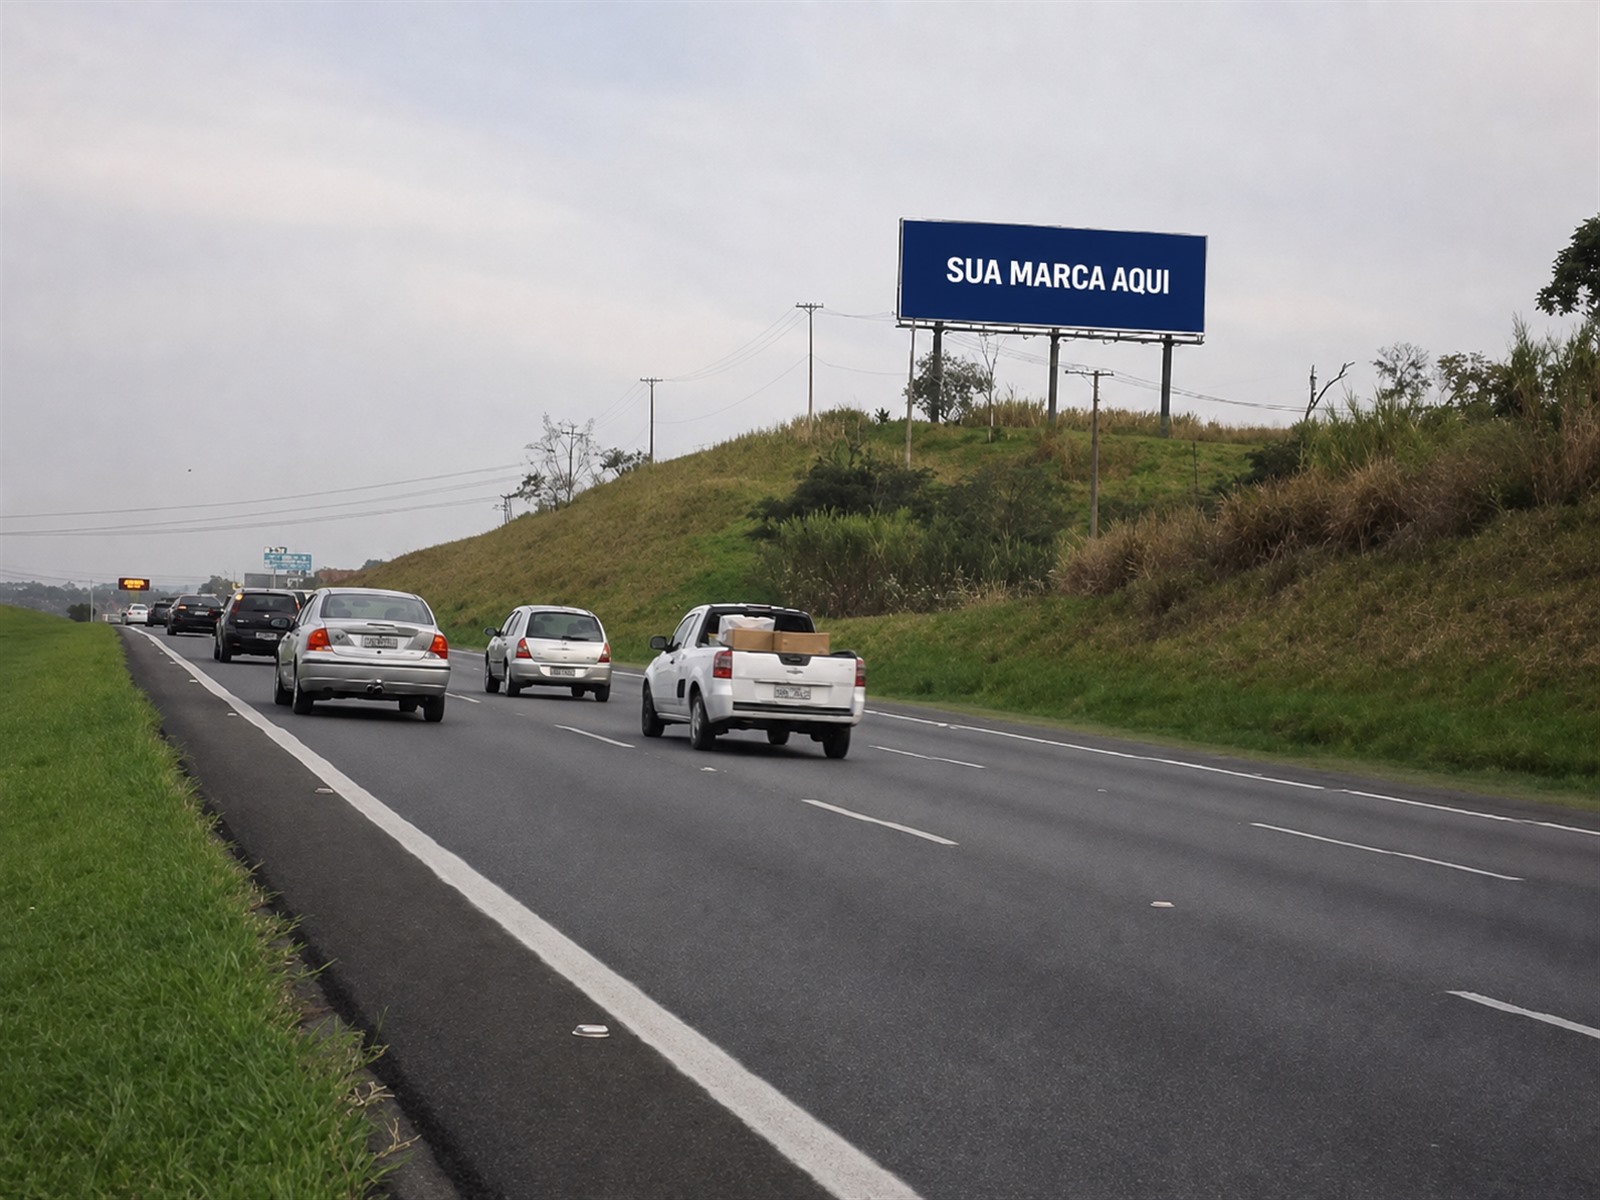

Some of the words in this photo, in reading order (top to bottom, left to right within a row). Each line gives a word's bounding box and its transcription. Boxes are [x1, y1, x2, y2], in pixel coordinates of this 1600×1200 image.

[946, 256, 1003, 285] SUA
[1010, 260, 1106, 291] MARCA
[1111, 266, 1170, 295] AQUI
